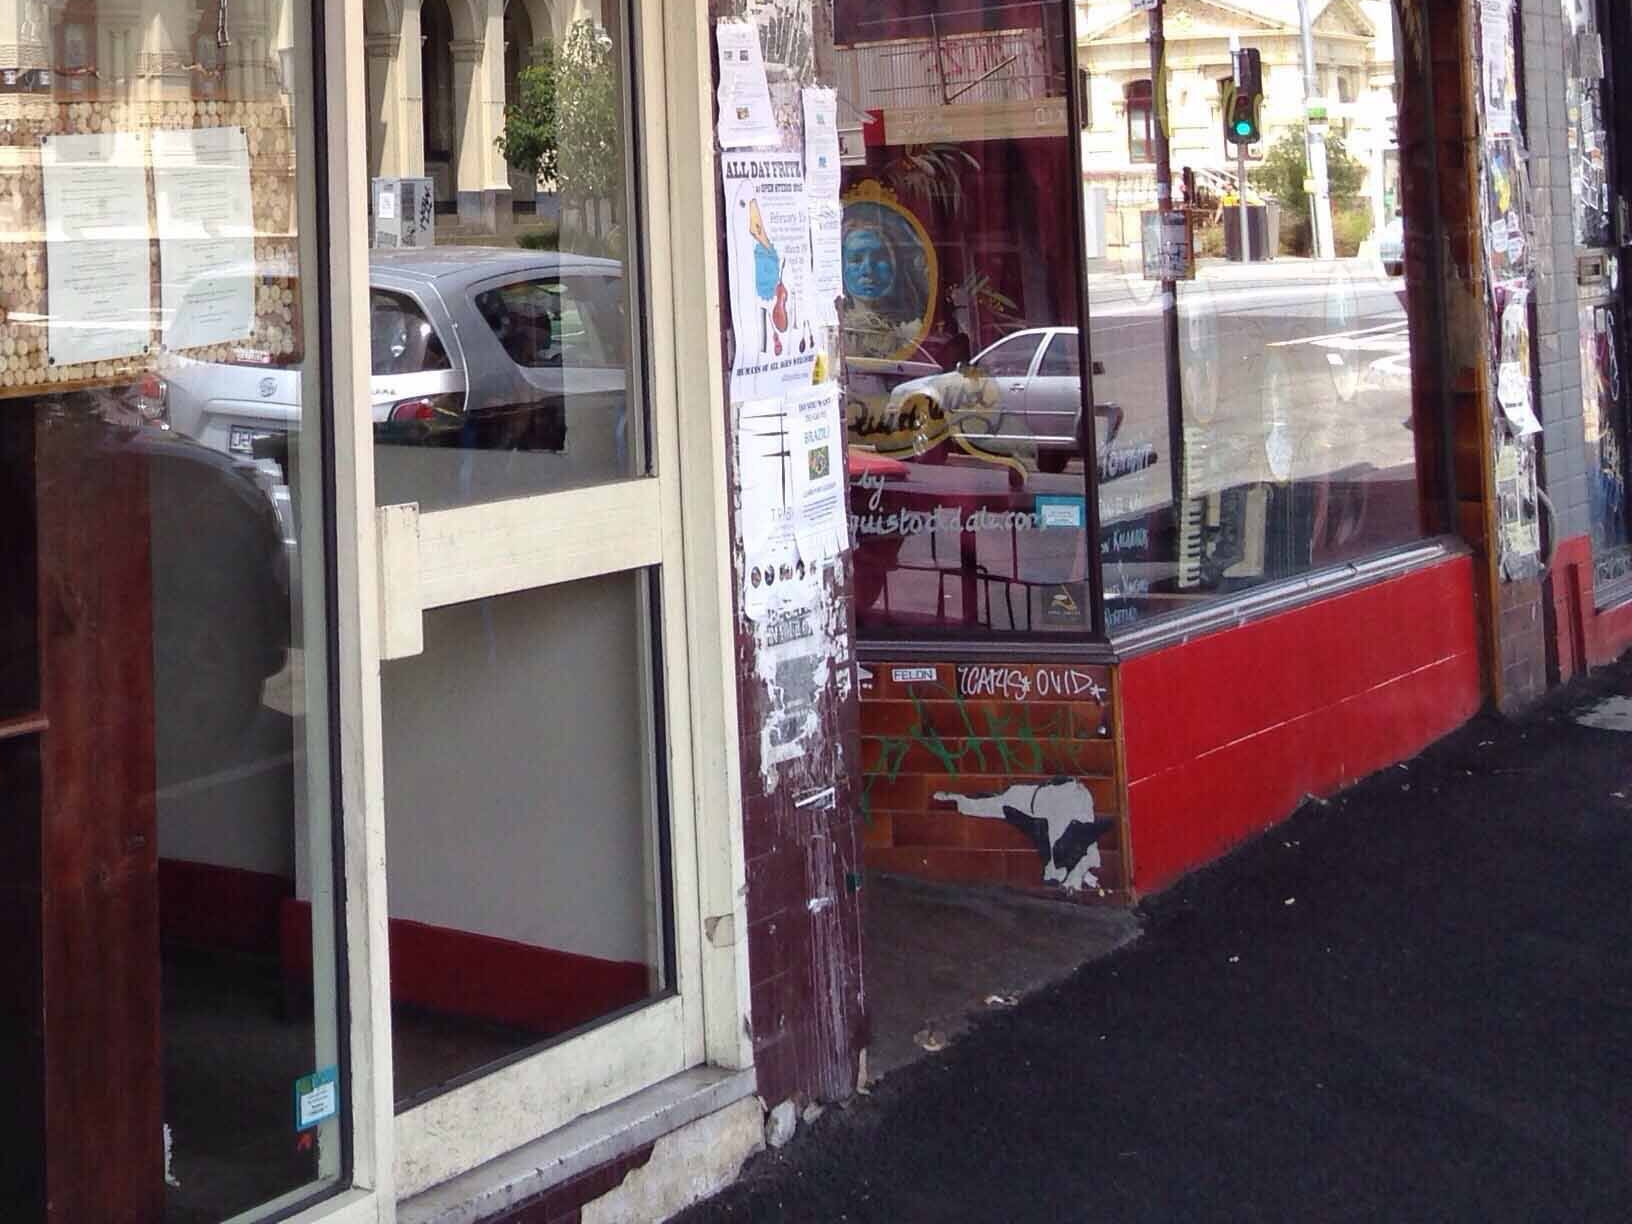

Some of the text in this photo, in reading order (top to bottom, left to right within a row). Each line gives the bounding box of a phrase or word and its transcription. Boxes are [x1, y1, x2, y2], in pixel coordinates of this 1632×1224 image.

[726, 161, 749, 178] ALL
[750, 161, 770, 178] DAY
[1036, 669, 1093, 695] OVID
